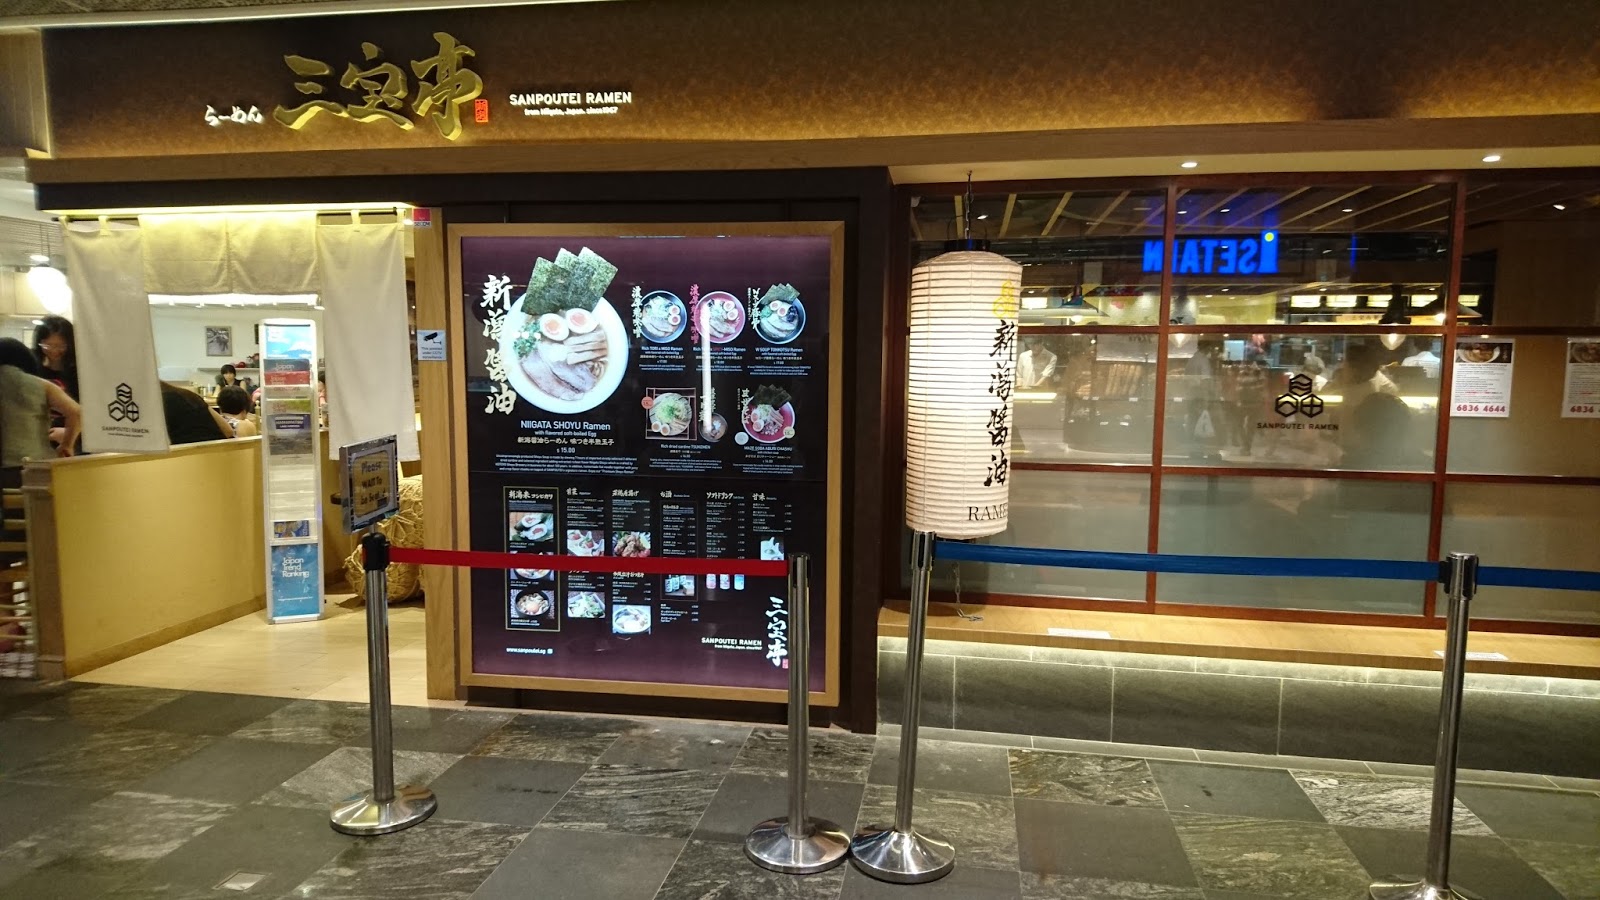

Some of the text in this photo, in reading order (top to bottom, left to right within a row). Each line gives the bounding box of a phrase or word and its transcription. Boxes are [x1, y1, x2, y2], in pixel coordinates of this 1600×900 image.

[509, 92, 632, 106] SANPOUTEI RAMEN
[204, 105, 264, 127] らーめん
[524, 108, 540, 116] from
[983, 319, 1015, 487] 新潟醤油
[1456, 404, 1506, 413] 6836 4644
[1570, 405, 1594, 413] 6836
[520, 420, 611, 431] NIIGATA SHOYU Ramen
[701, 637, 737, 645] SANPOUTEI
